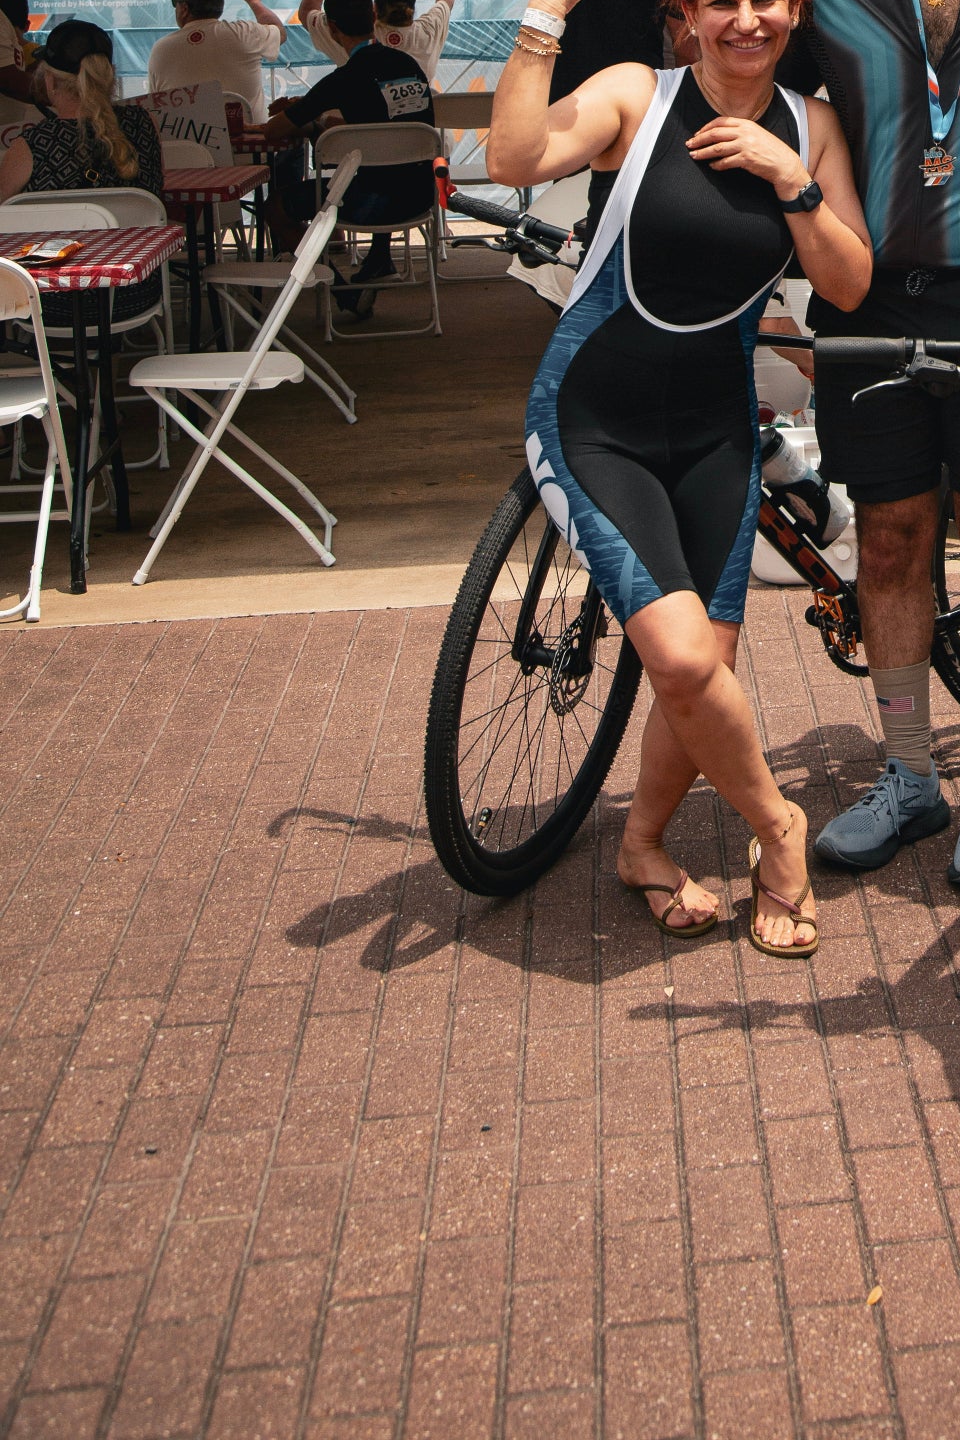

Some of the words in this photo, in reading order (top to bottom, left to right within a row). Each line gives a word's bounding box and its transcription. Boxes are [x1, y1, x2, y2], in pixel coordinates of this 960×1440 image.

[34, 0, 66, 9] Powered
[67, 0, 77, 9] by
[390, 82, 424, 101] 2683
[150, 109, 227, 150] HINE
